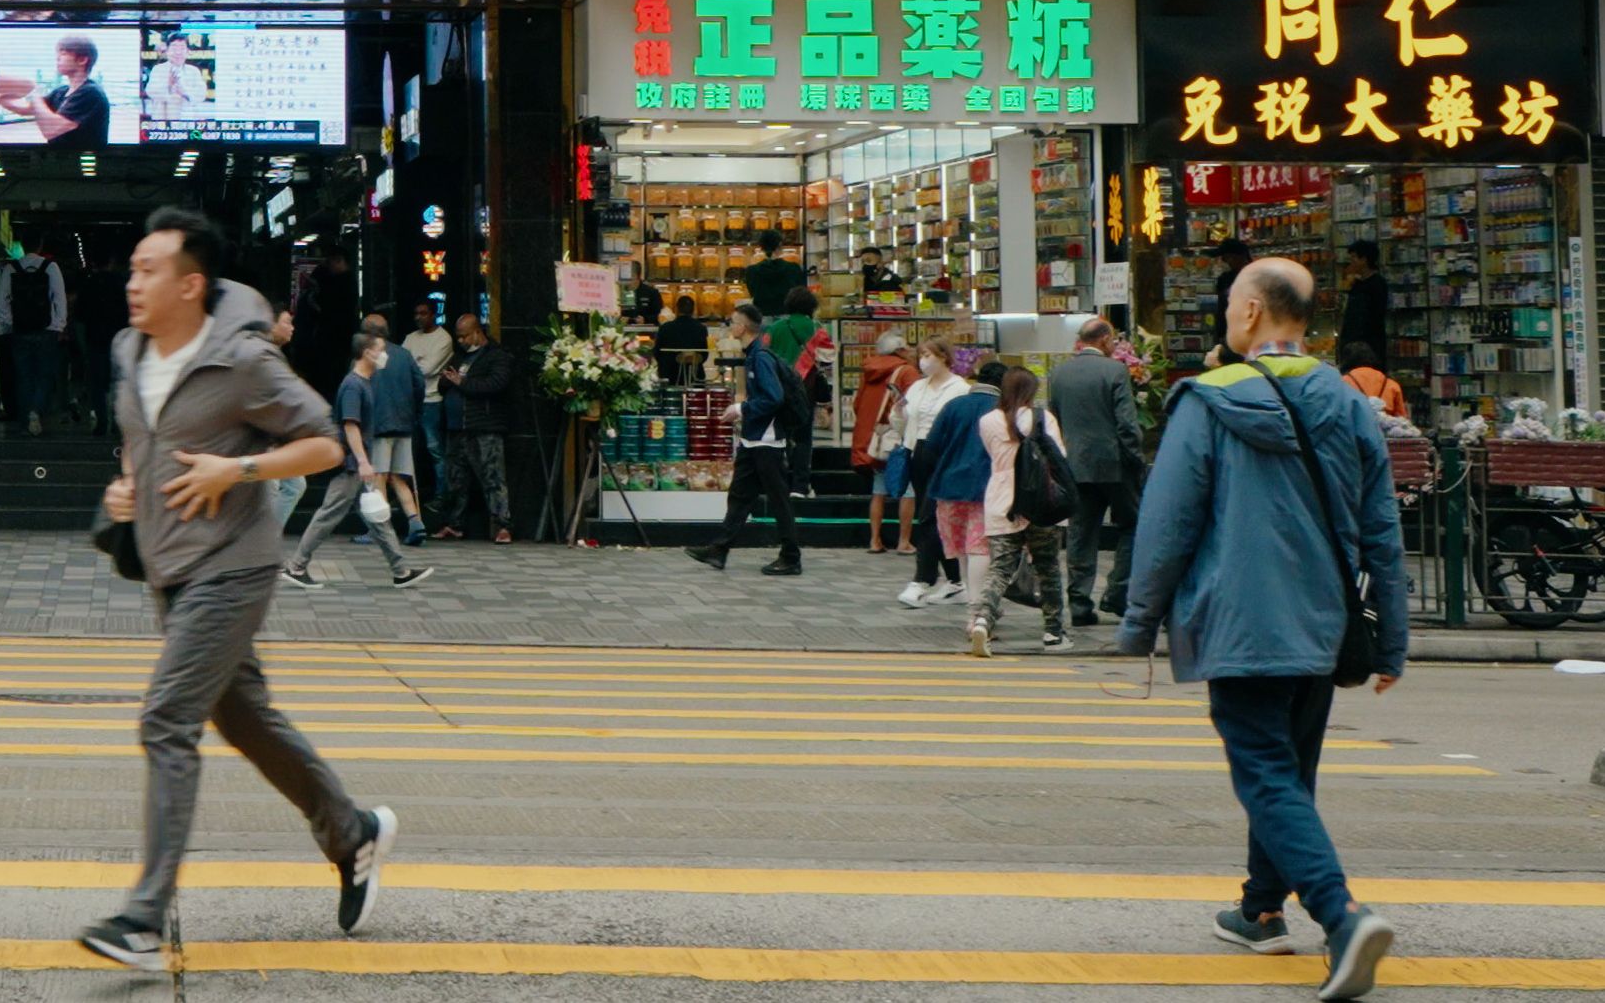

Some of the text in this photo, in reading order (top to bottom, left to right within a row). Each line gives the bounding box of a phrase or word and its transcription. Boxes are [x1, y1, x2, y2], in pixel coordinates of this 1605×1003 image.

[634, 82, 1094, 113] 政府註冊 環球西藥 全國包郵
